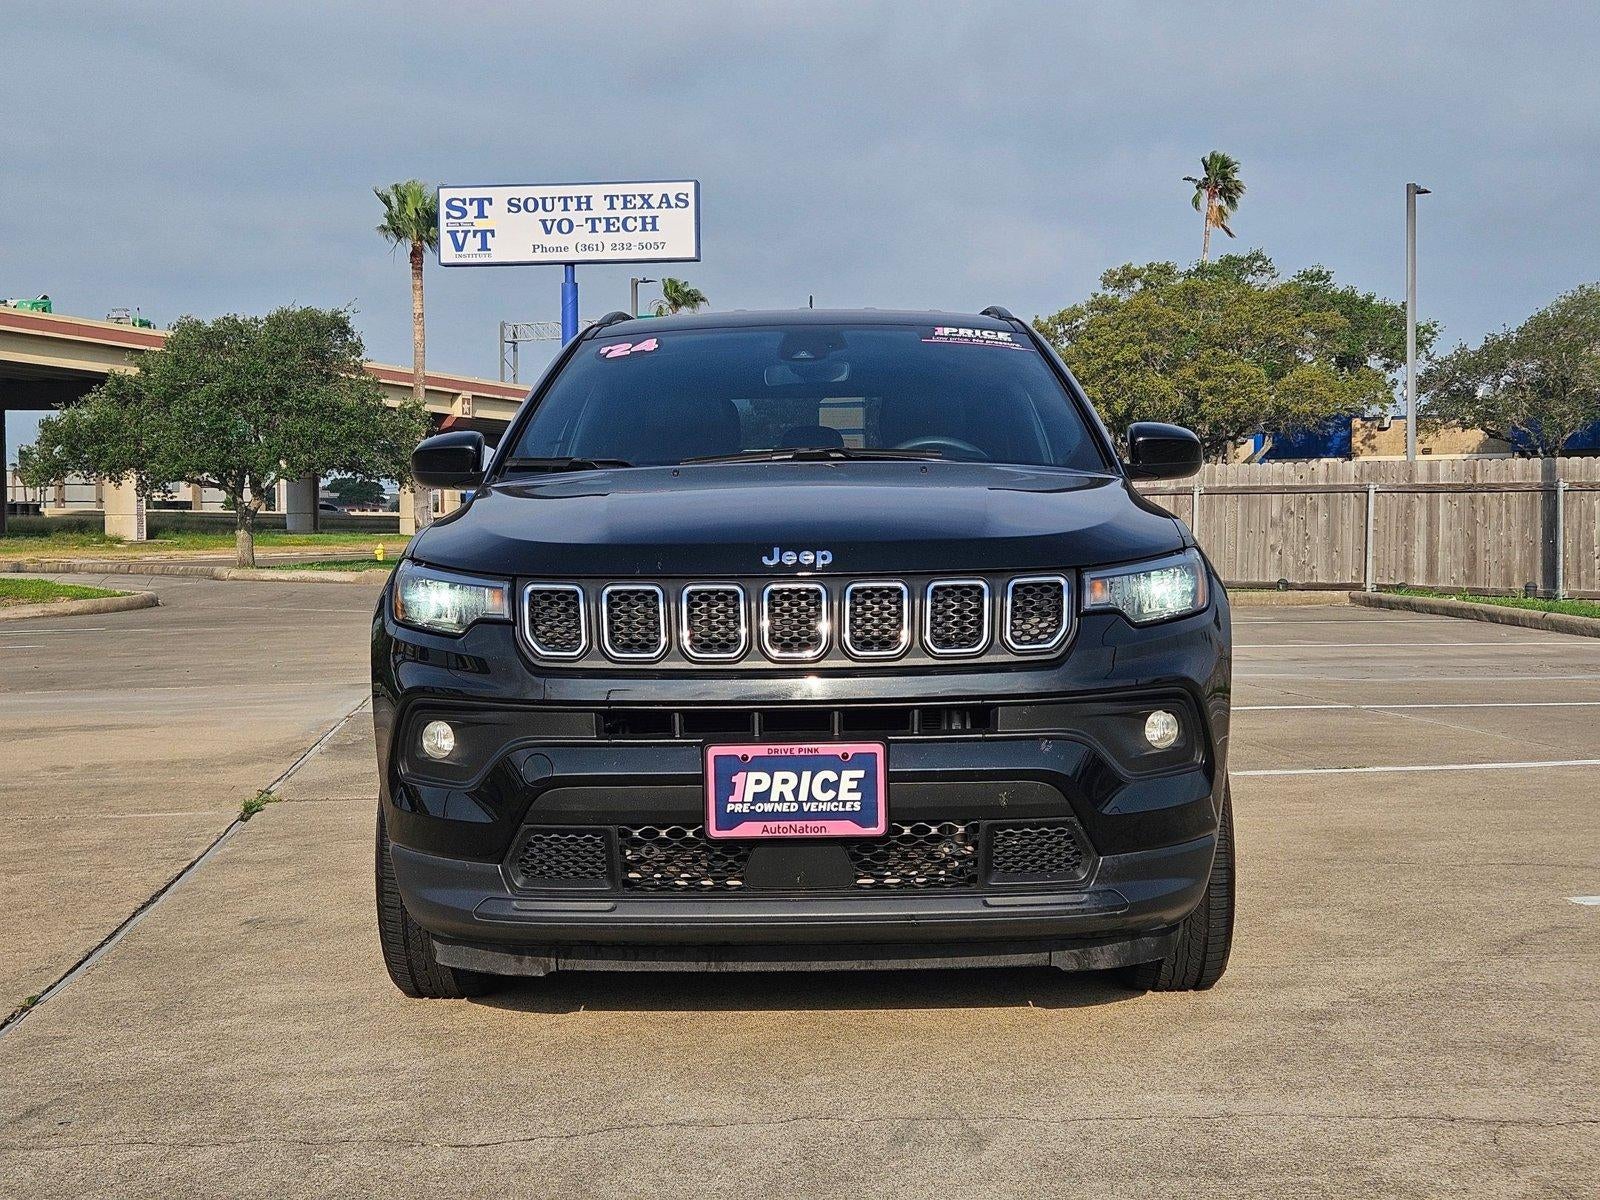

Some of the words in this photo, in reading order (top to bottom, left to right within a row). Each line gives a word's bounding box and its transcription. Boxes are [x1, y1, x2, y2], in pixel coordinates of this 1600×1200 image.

[445, 197, 493, 220] ST
[507, 195, 593, 214] SOUTH
[604, 192, 690, 211] TEXAS
[539, 215, 660, 235] VO-TECH
[446, 229, 496, 252] VT
[531, 243, 569, 254] Phone
[574, 241, 605, 252] (361)
[610, 241, 667, 252] 232-5057
[934, 326, 1011, 340] 1PRICE
[762, 547, 833, 570] Jeep
[729, 770, 865, 802] 1PRICE
[727, 802, 799, 813] PRE-OWNED
[803, 801, 861, 812] VEHICLES
[761, 824, 827, 835] AutoNation
